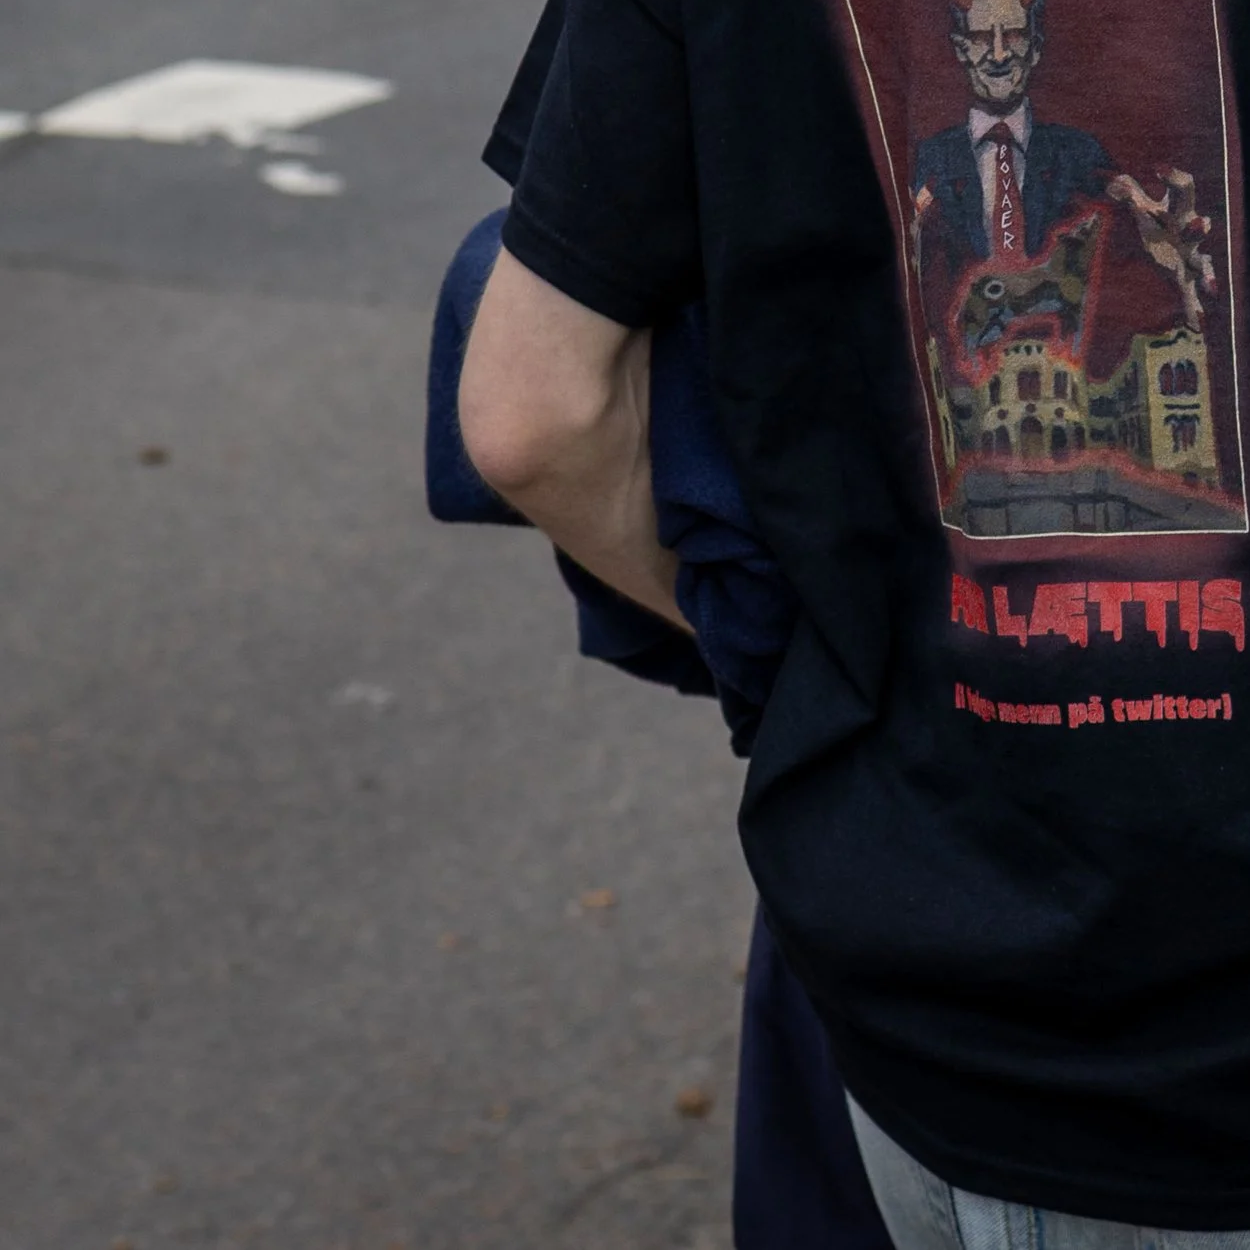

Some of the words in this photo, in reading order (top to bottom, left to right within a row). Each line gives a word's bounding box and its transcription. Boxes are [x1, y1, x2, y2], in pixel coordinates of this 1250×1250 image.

[1000, 144, 1016, 250] BOVAER
[992, 578, 1246, 652] LÆTTIS
[1068, 695, 1105, 729] på
